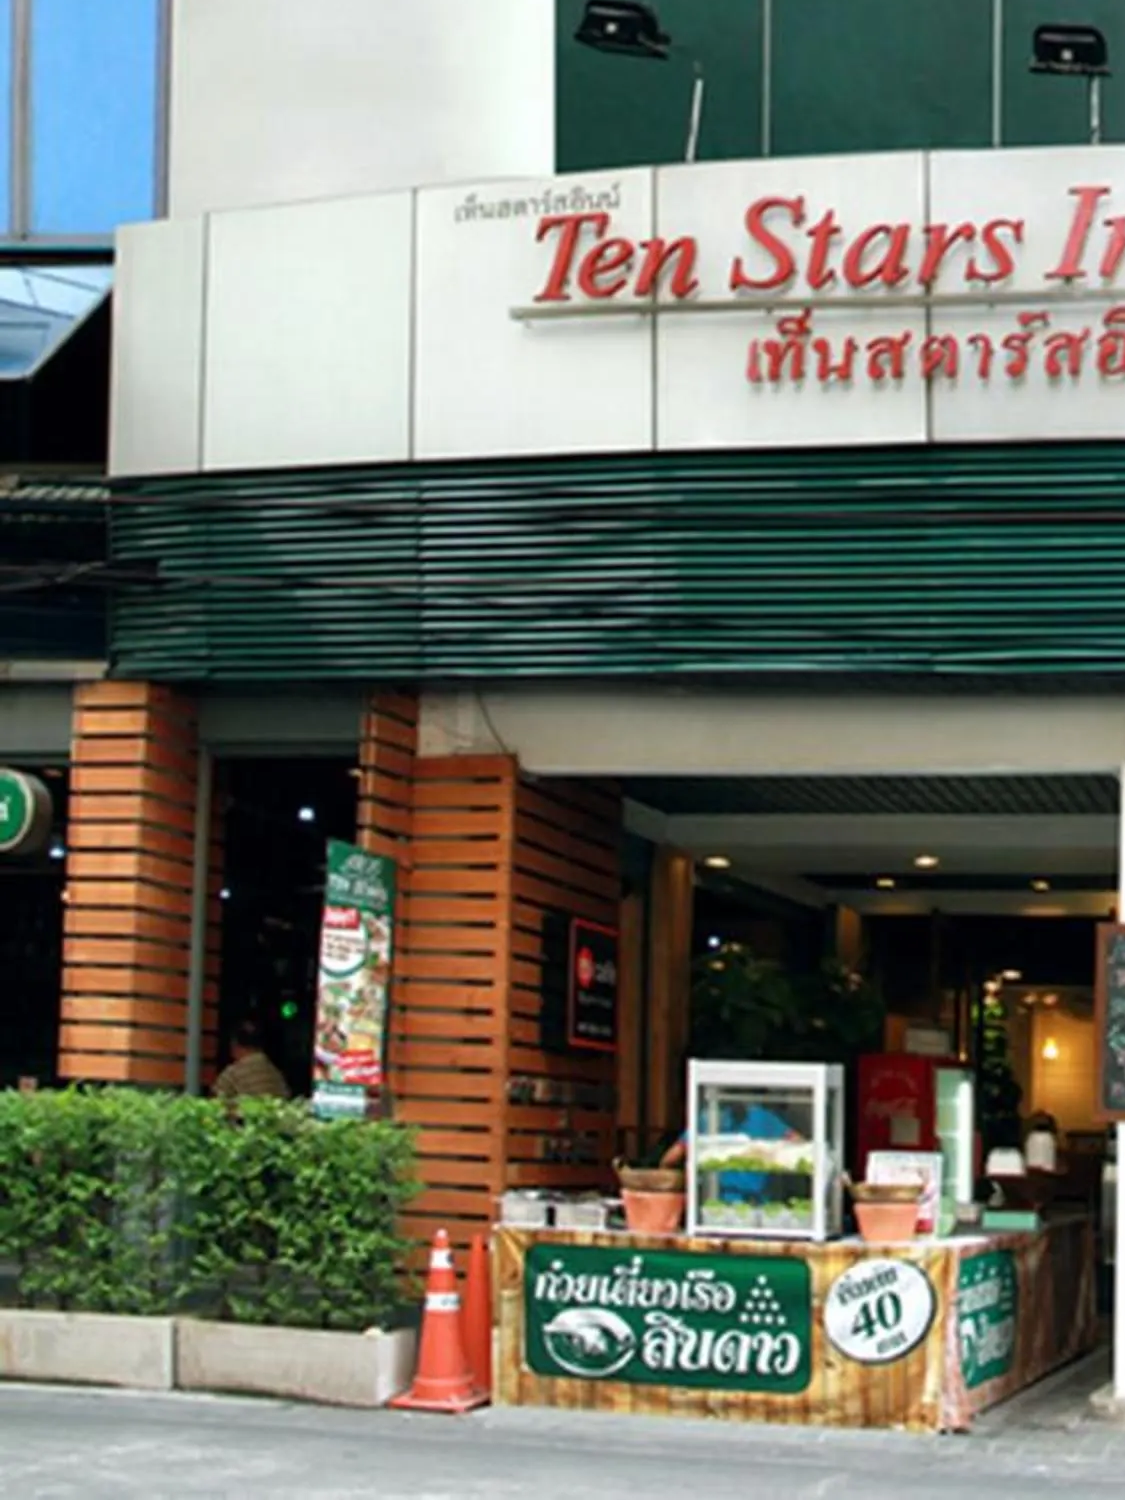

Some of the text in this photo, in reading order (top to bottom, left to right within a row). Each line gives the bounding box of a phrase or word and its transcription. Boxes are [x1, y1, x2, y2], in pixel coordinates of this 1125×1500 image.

[532, 211, 700, 301] Ten
[728, 195, 1024, 291] Stars
[851, 1290, 902, 1339] 40
